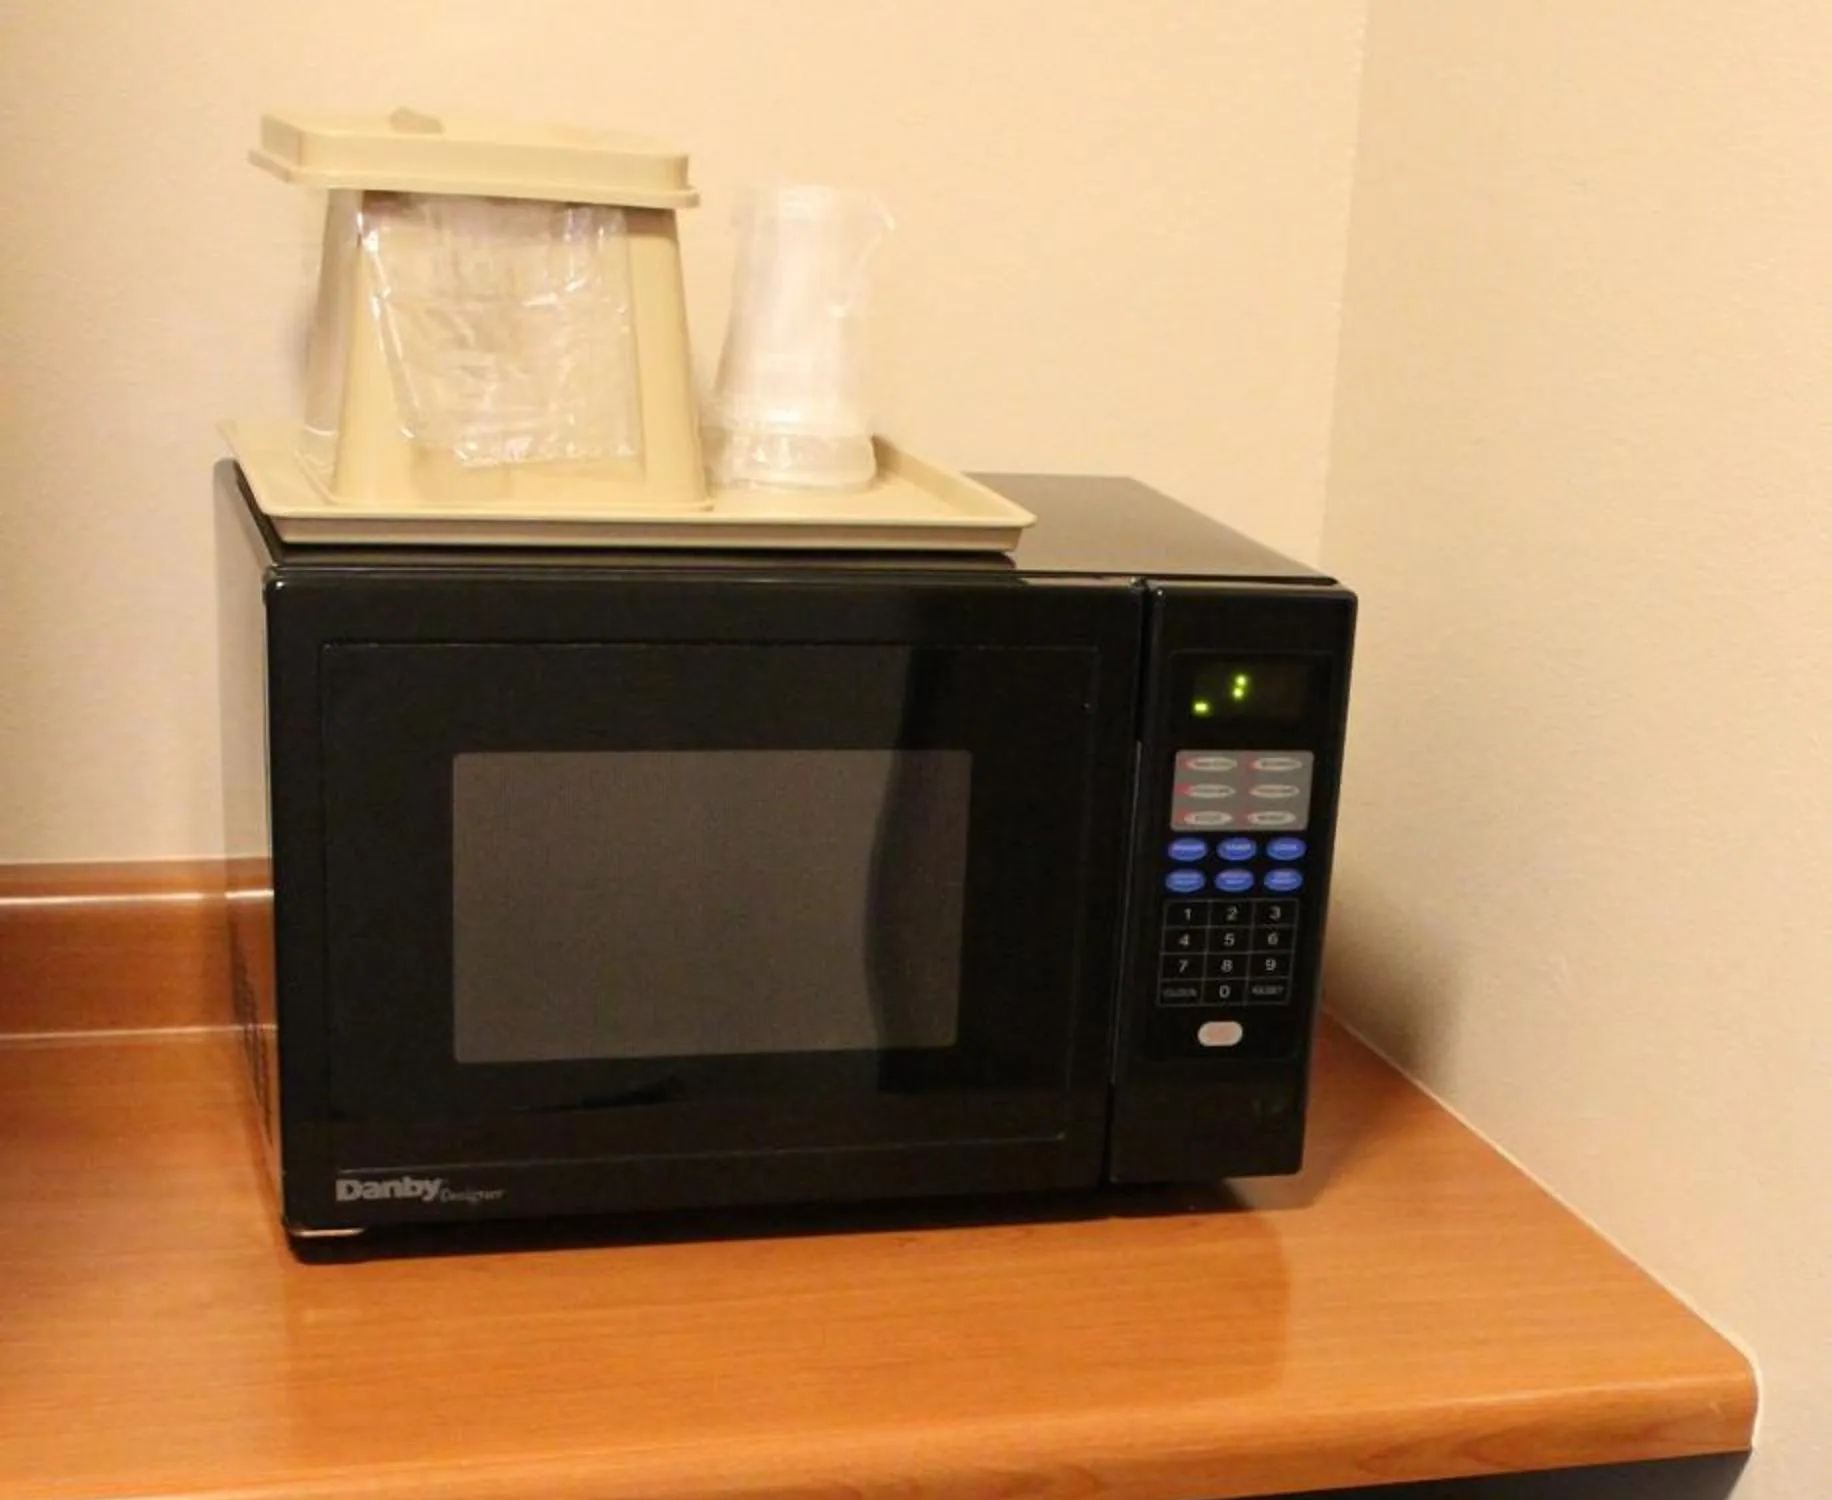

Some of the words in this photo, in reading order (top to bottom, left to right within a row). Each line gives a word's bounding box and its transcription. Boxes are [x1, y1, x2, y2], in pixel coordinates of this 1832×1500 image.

[1183, 907, 1192, 921] 1
[1226, 906, 1239, 921] 2
[1269, 905, 1282, 920] 3
[1179, 934, 1190, 946] 4
[1224, 932, 1235, 946] 5
[1267, 932, 1279, 945] 6
[1179, 959, 1189, 973] 7
[1221, 959, 1233, 973] 8
[1265, 958, 1277, 972] 9
[1218, 984, 1231, 999] 0
[335, 1175, 441, 1202] Danby
